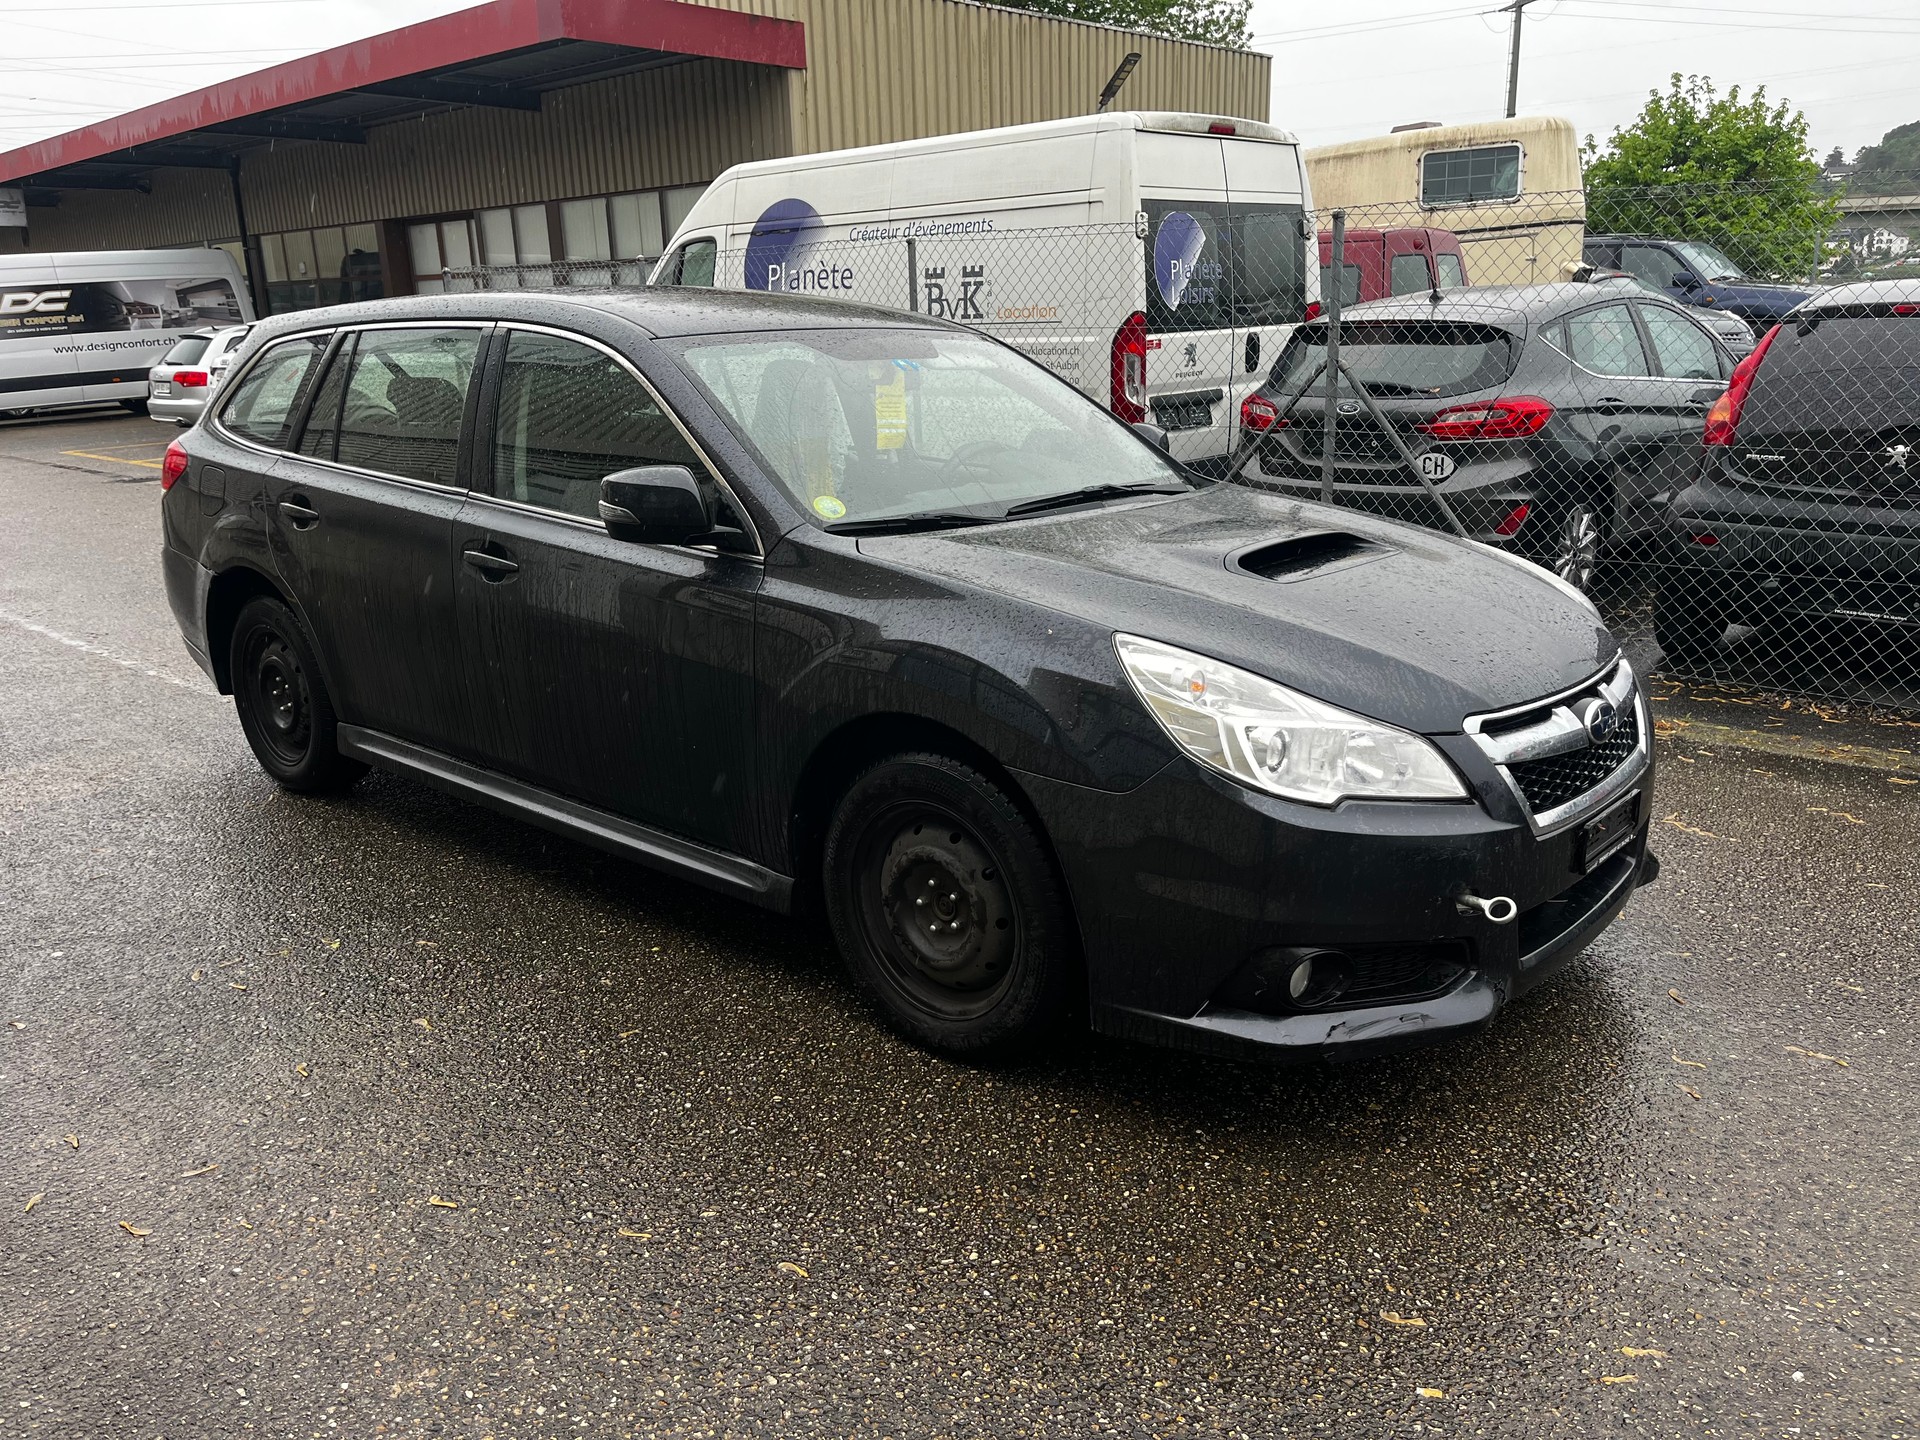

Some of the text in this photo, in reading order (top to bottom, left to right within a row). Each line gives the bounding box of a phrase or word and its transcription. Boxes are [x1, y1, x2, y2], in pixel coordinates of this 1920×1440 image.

[849, 226, 901, 242] Créateur
[768, 261, 853, 291] Planète
[1170, 257, 1223, 280] Planète
[1171, 283, 1215, 304] Loisirs
[997, 304, 1057, 319] Location
[53, 337, 176, 354] www.designconfort.ch
[1175, 370, 1203, 378] PEUGEOT
[1422, 456, 1445, 475] CH
[1746, 453, 1786, 461] PEUGEOT
